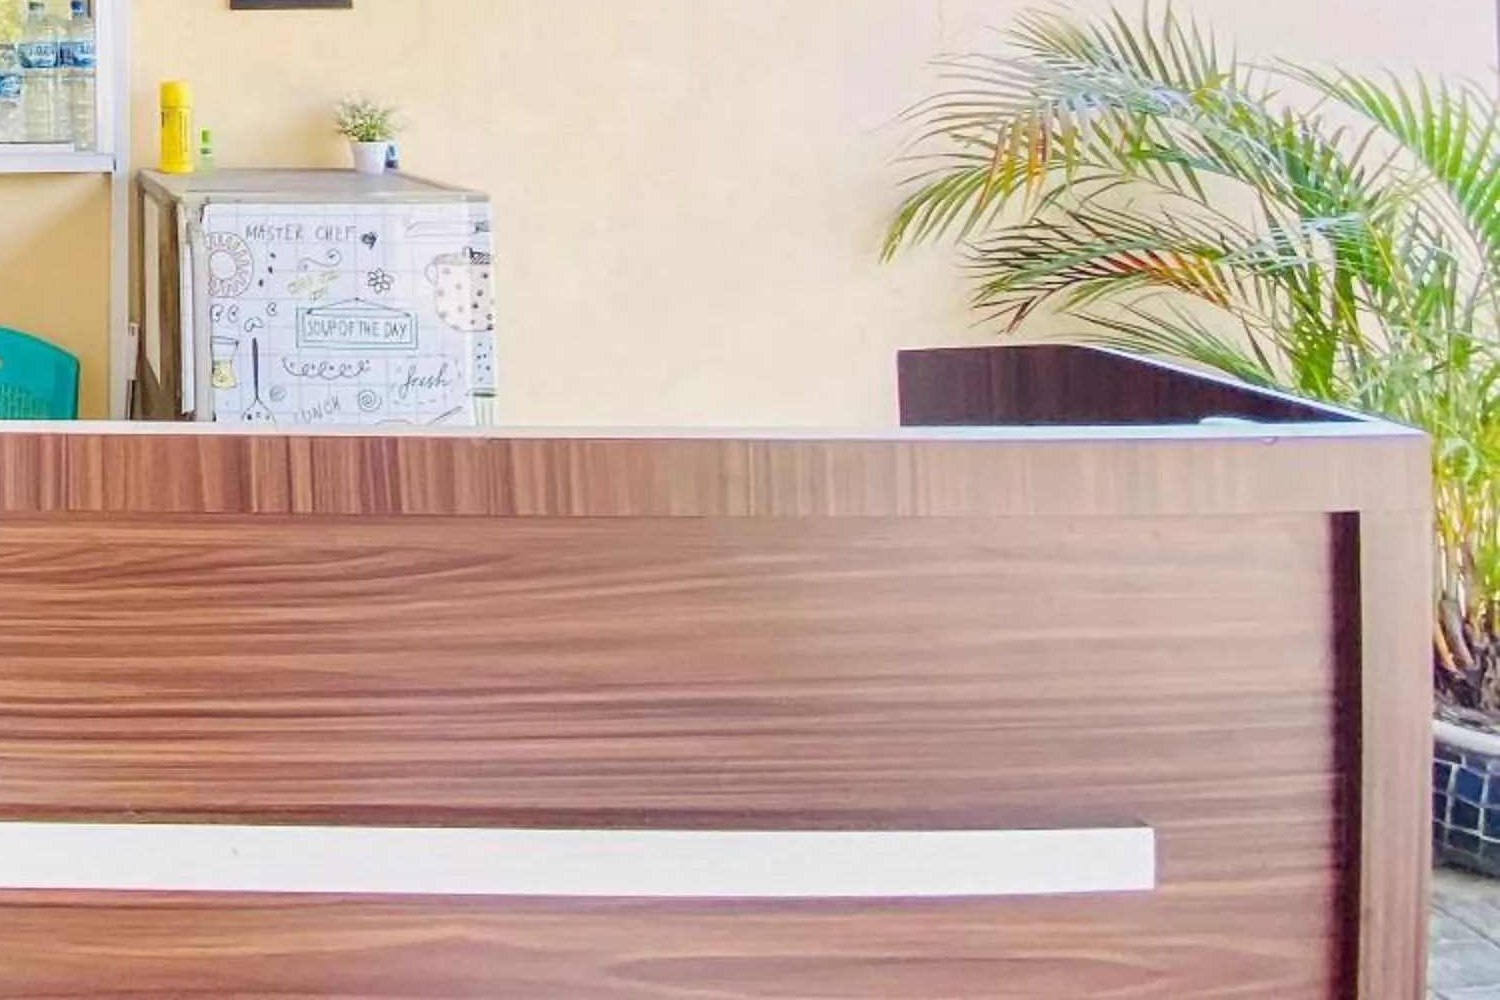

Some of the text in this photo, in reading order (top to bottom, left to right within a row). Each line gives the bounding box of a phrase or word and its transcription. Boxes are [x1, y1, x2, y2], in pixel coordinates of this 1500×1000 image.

[245, 224, 356, 242] MASTER CHEF
[358, 320, 382, 337] THE
[384, 322, 408, 339] DAY
[399, 364, 451, 399] fresh
